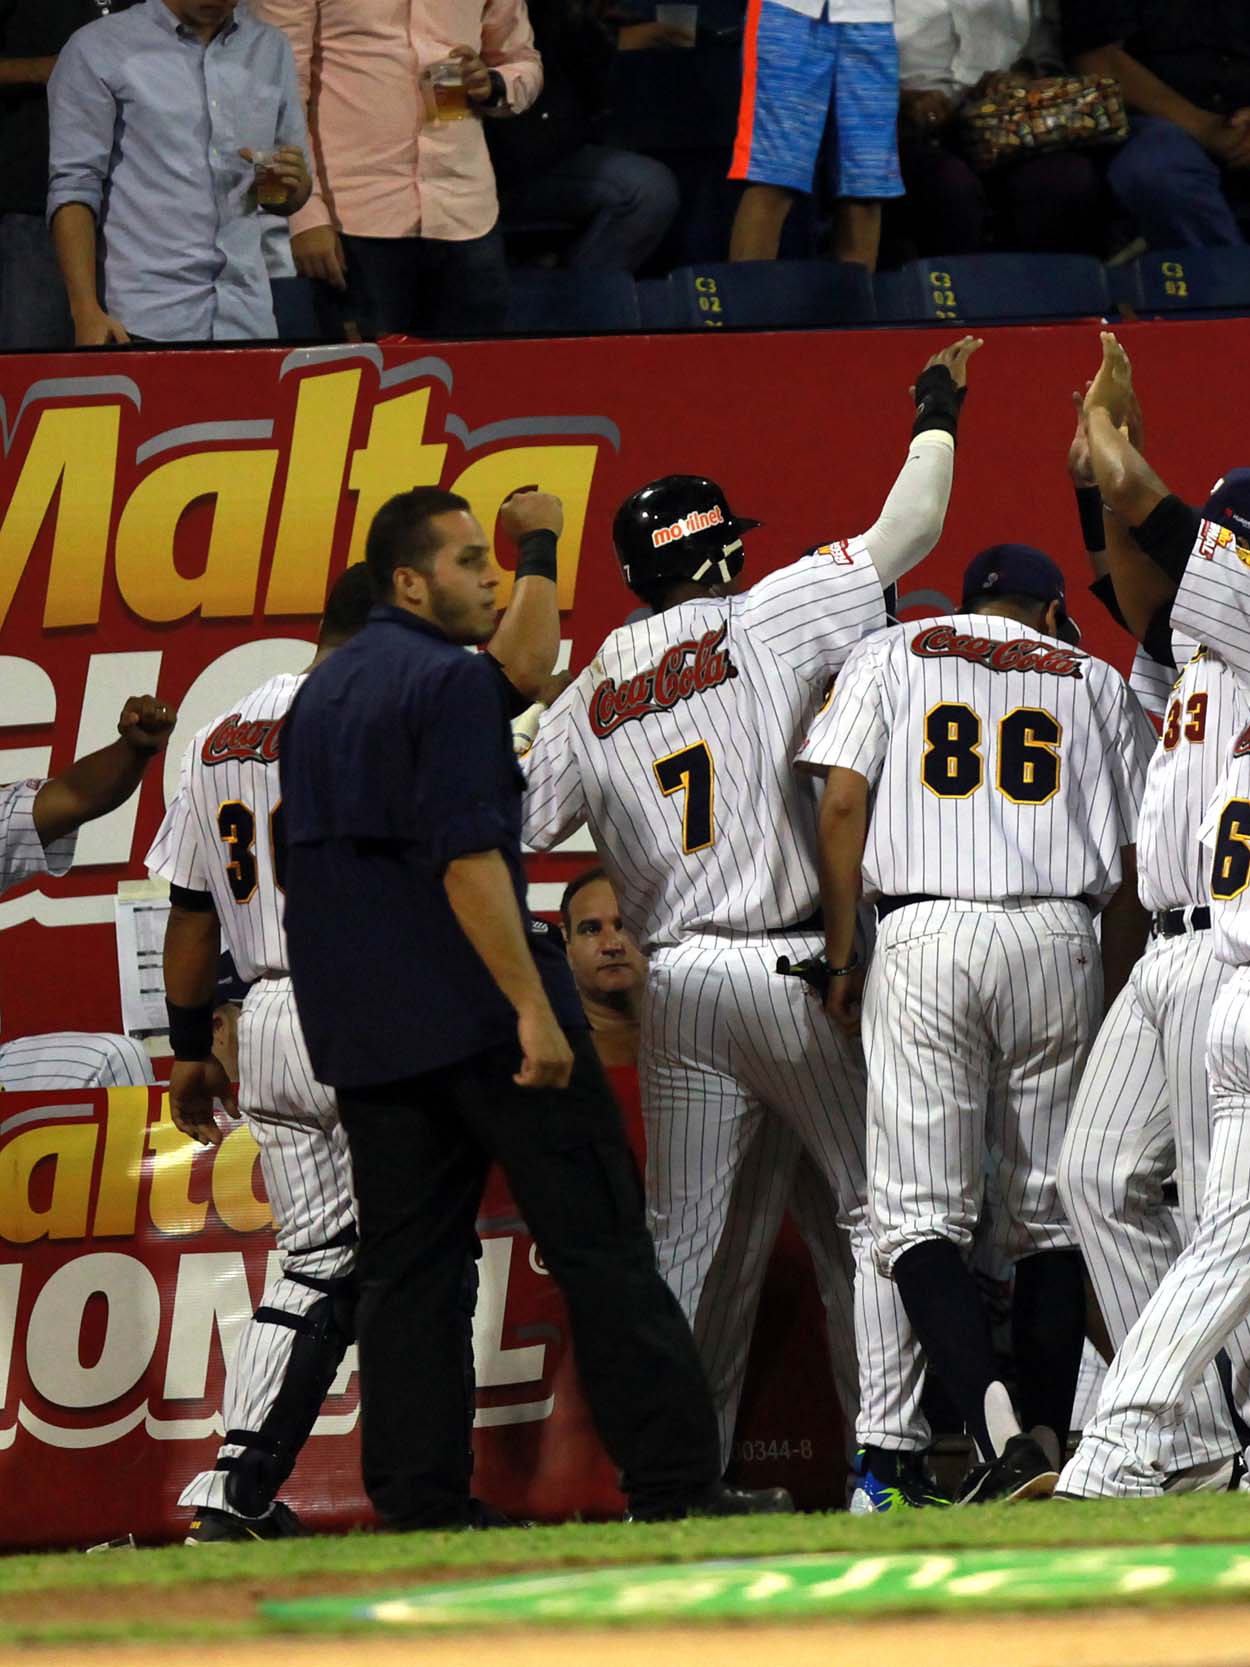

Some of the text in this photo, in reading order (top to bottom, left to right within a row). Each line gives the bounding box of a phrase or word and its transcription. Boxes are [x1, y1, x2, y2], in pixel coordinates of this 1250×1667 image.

[695, 277, 716, 293] C3
[929, 271, 951, 287] C3
[652, 505, 724, 548] movilnet
[589, 619, 739, 739] Coca-Cola
[911, 625, 1093, 679] Coca-Cola
[202, 713, 287, 766] Coca-C
[1163, 692, 1208, 751] 33
[921, 701, 1062, 805] 86
[652, 739, 715, 856] 7
